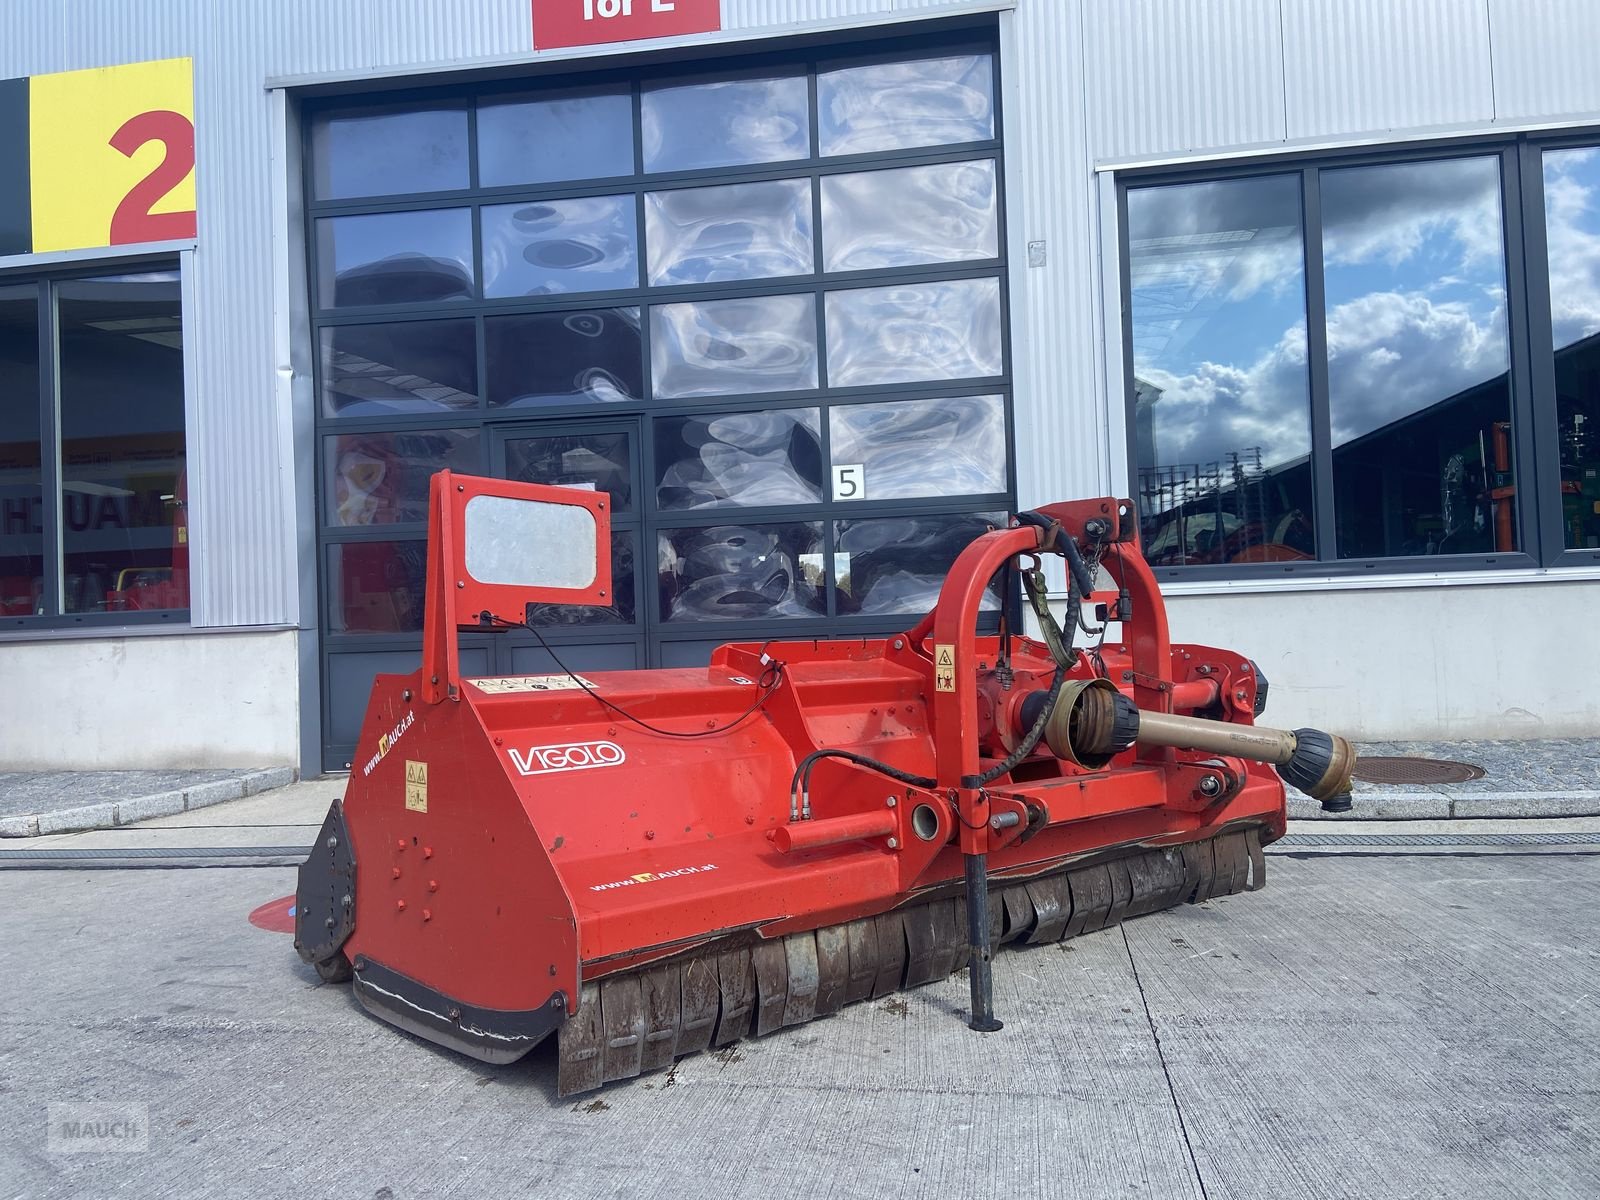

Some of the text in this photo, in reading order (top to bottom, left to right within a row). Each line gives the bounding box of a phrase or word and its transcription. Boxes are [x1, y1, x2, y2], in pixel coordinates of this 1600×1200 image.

[108, 110, 197, 246] 2
[839, 469, 857, 497] 5
[363, 709, 416, 777] www.MAUCH.at
[507, 743, 623, 774] VIGOLO
[590, 862, 719, 891] www.MAUCH.at
